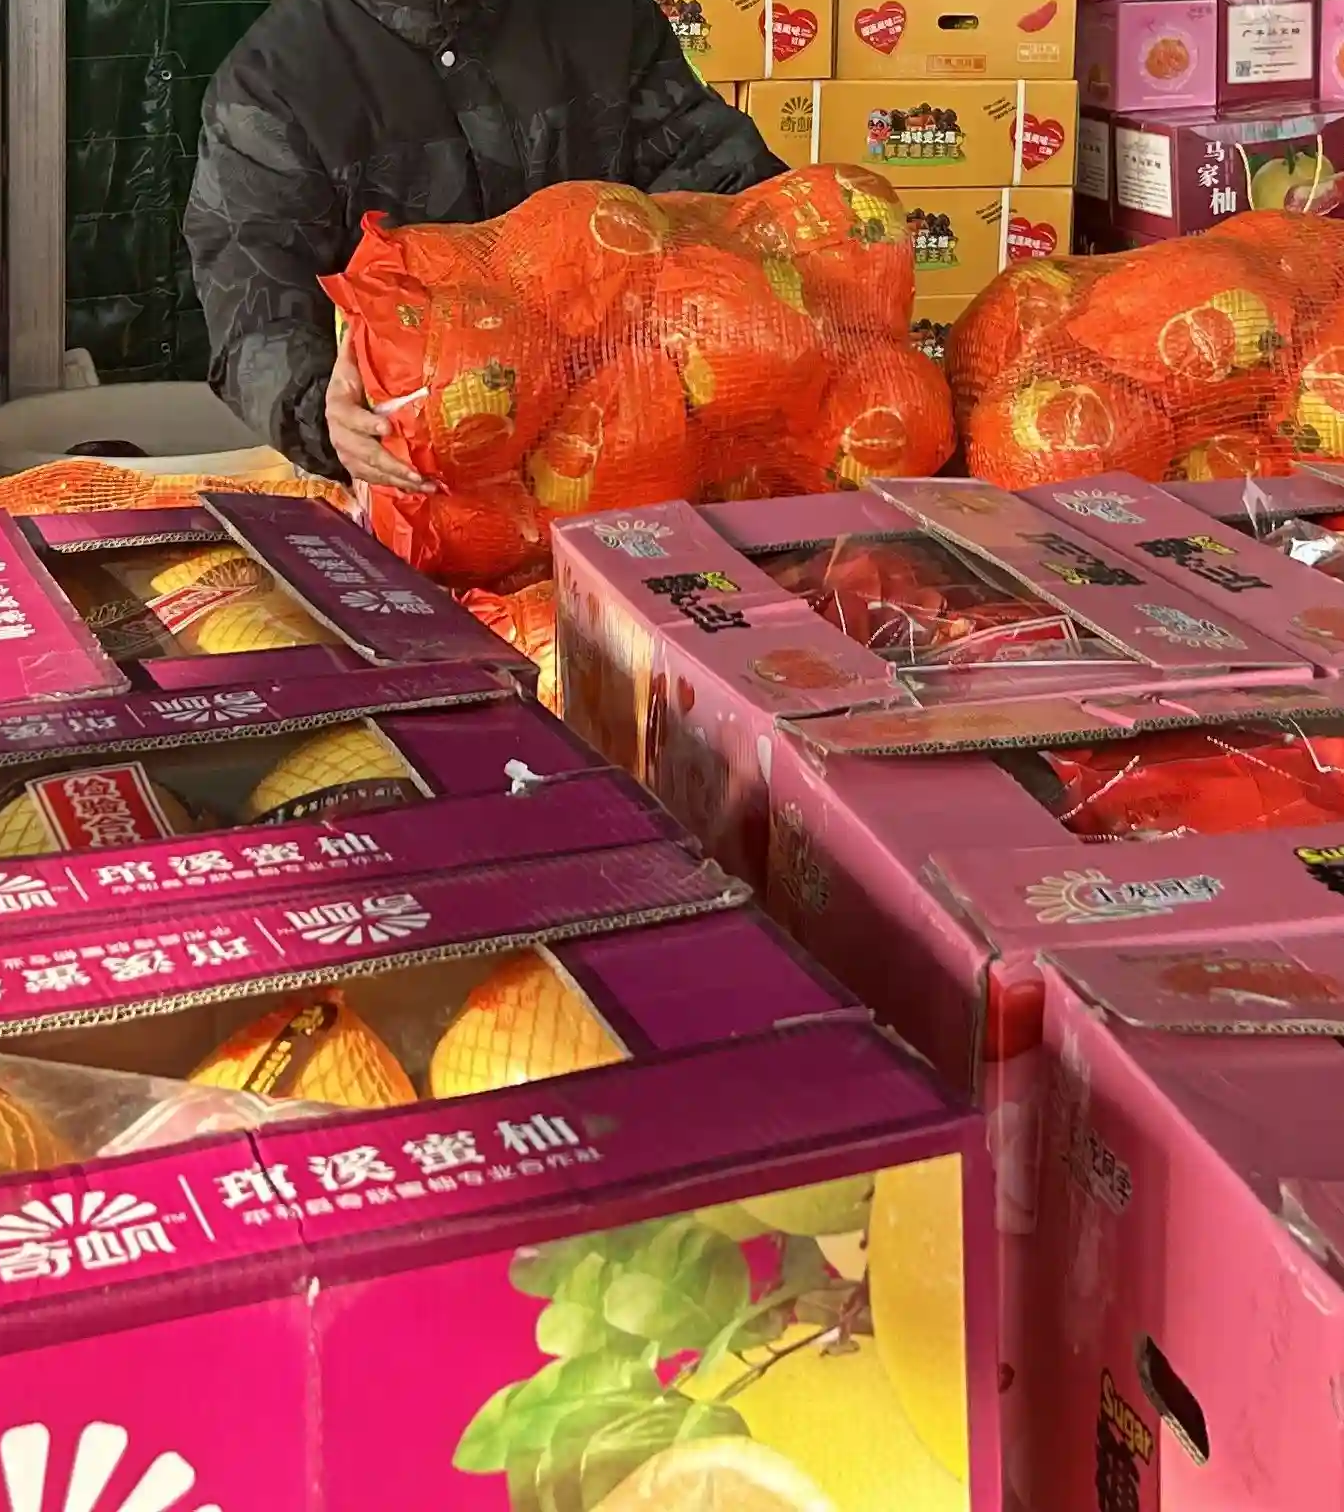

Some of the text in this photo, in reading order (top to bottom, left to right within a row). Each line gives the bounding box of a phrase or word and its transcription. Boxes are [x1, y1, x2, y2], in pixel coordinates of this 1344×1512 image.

[889, 131, 956, 145] 一场味觉之旅
[1197, 140, 1237, 216] 马家柚
[97, 831, 380, 886] 琯溪蜜柚
[213, 1111, 581, 1211] 琯溪蜜柚
[1101, 1368, 1154, 1466] Sugar
